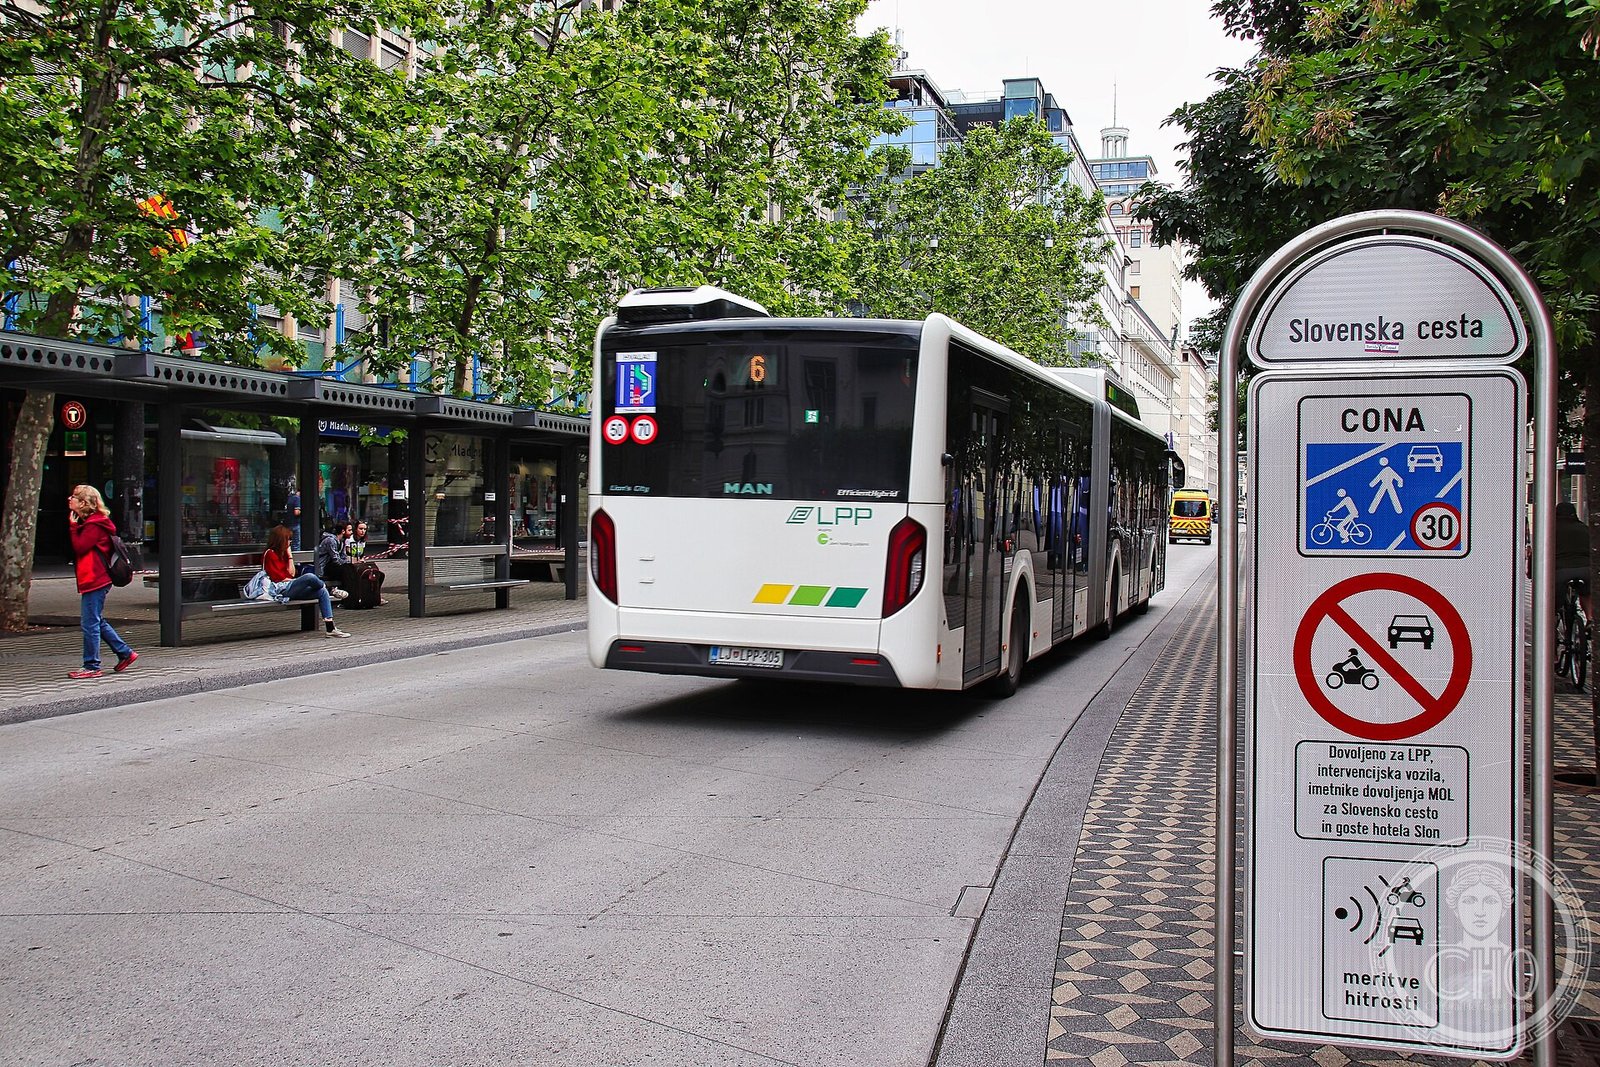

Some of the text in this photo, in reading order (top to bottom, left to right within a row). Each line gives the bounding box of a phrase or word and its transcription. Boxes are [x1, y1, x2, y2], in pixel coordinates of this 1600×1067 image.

[1289, 313, 1483, 343] Slovenska cesta
[750, 355, 765, 382] 6
[609, 422, 624, 437] 50
[637, 422, 652, 437] 70
[1341, 407, 1426, 433] CONA
[724, 482, 773, 495] MAN
[836, 489, 899, 498] EfficientHybrid
[817, 506, 873, 525] LPP
[1421, 514, 1452, 541] 30
[1329, 745, 1434, 764] Dovoljeno za LPP,
[1317, 763, 1445, 783] intervencijska vozila,
[1308, 781, 1455, 803] imetnike dovoljenja MOL
[1323, 802, 1439, 820] za Slovensko cesto
[1321, 819, 1440, 839] in goste hotela Slon
[1343, 972, 1420, 989] meritve
[1345, 990, 1418, 1011] hitrosti
